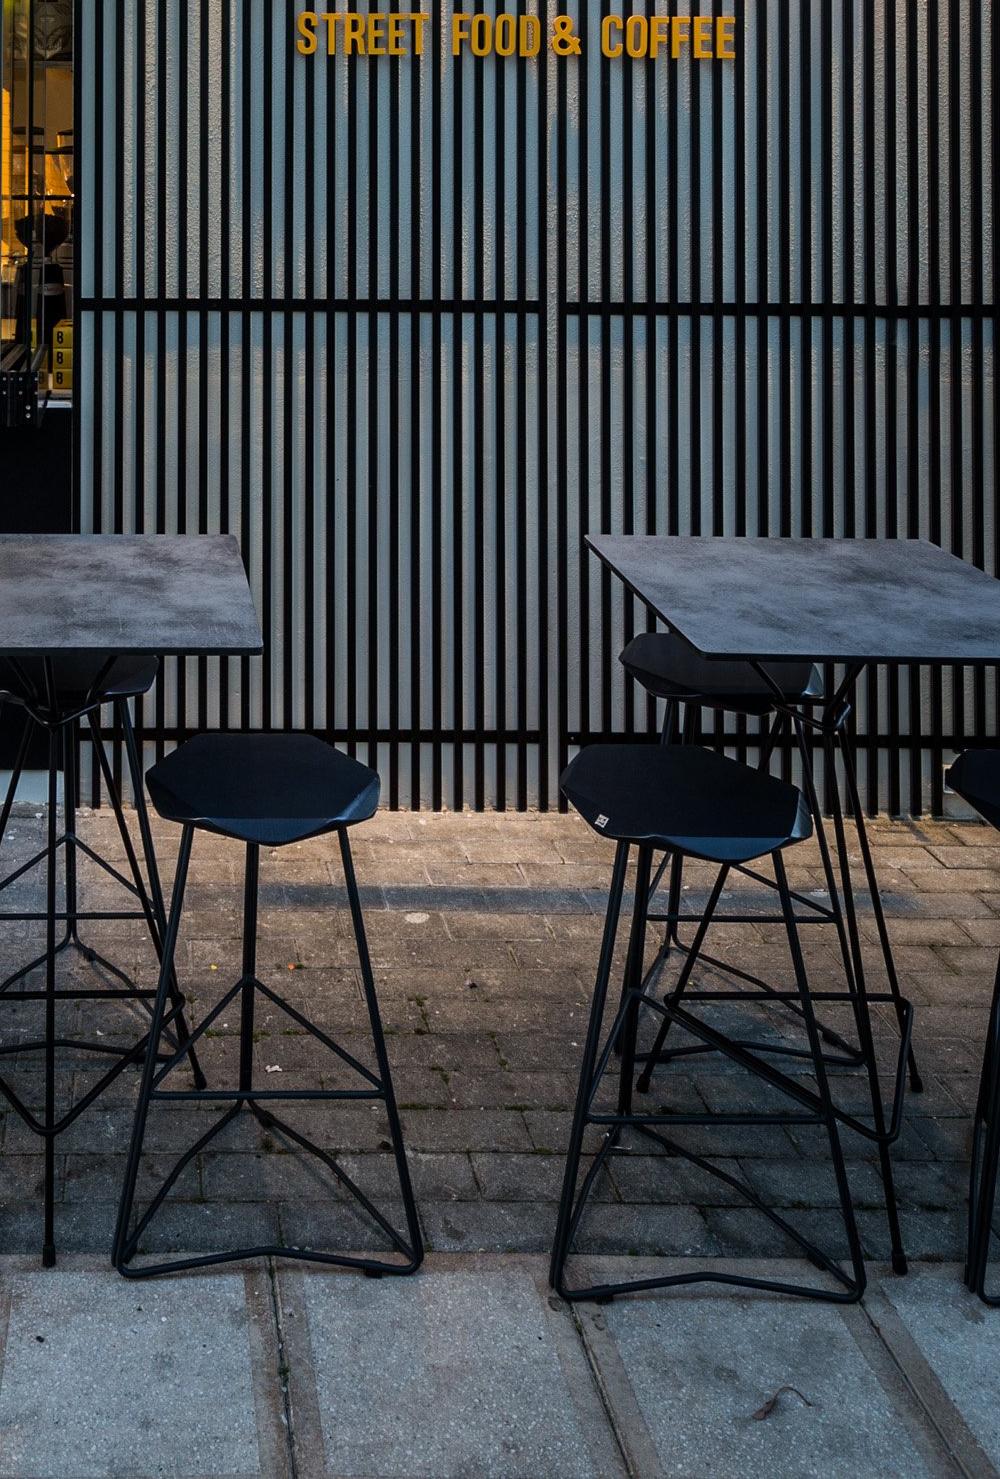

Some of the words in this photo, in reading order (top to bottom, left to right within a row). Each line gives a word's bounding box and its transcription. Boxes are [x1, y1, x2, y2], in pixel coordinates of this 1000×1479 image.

[297, 11, 429, 56] STREET
[452, 12, 541, 58] FOOD
[551, 14, 581, 57] &
[602, 15, 736, 60] COFFEE
